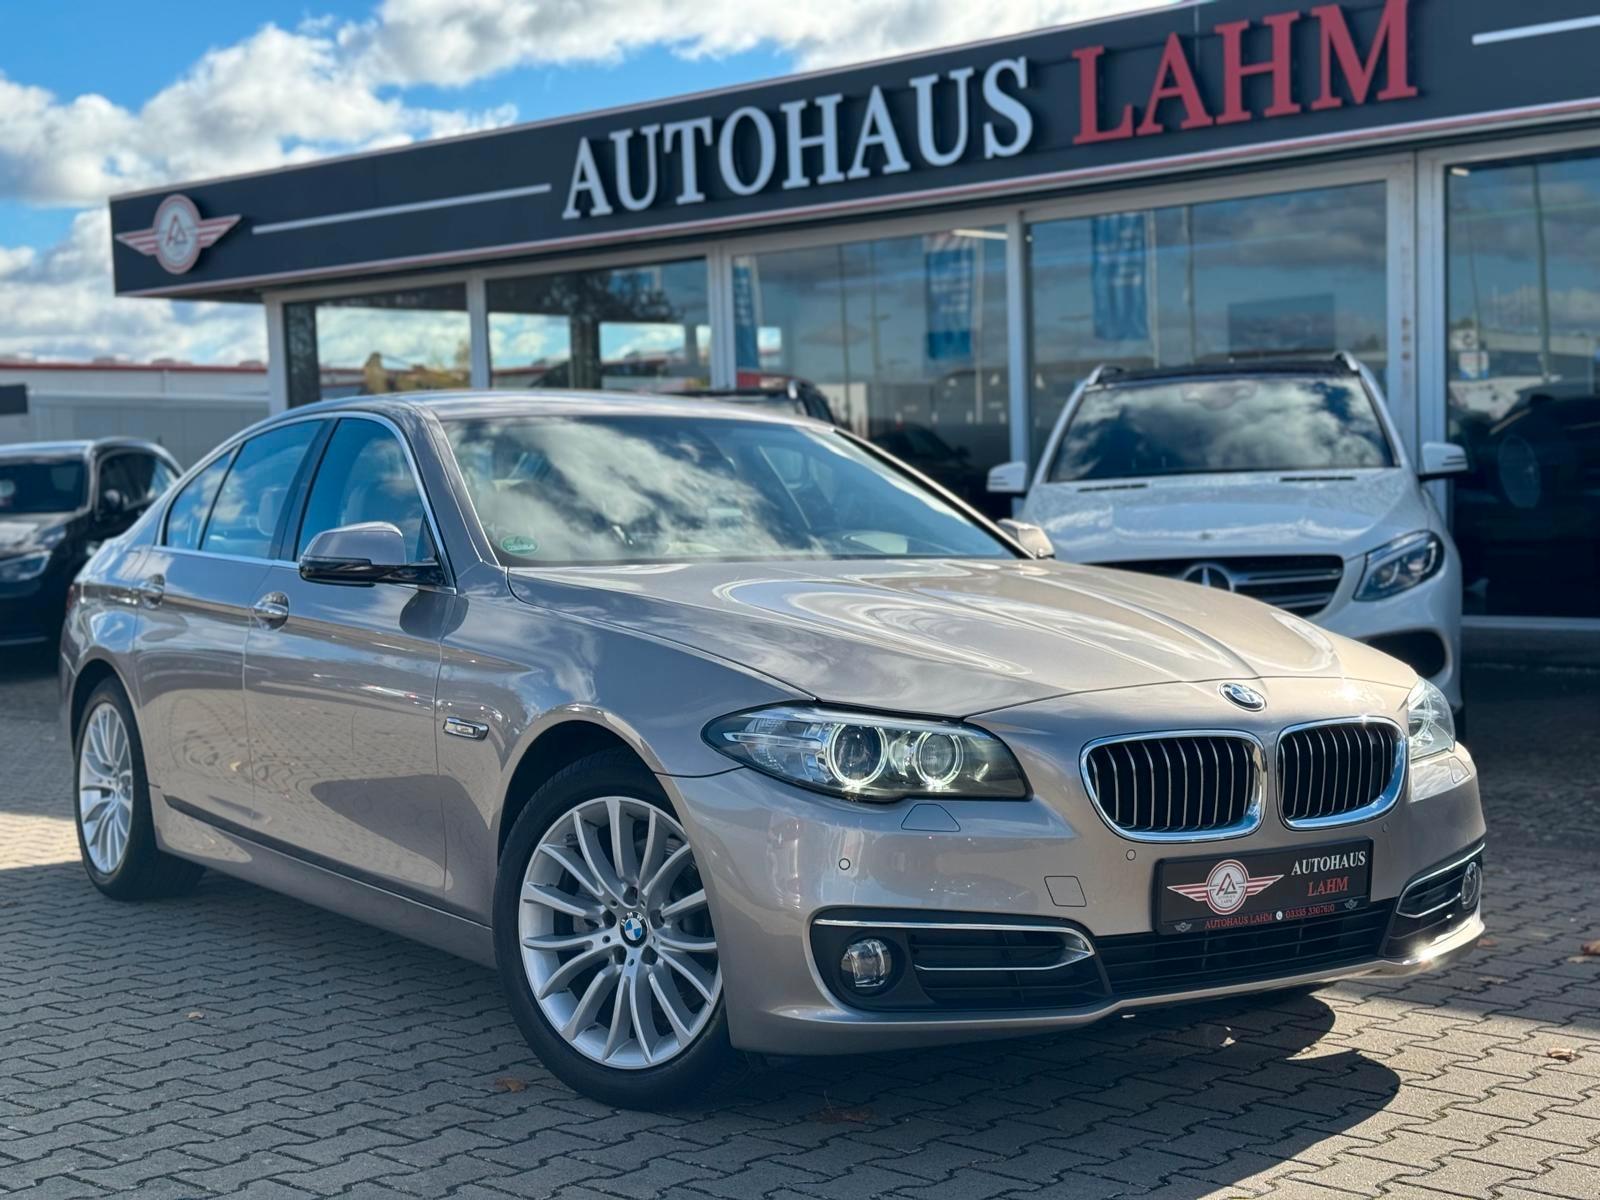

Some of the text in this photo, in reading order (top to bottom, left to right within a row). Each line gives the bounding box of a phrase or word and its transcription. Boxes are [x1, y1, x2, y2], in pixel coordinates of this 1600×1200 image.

[562, 0, 1418, 219] AUTOHAUS LAHM
[1291, 851, 1366, 875] AUTOHAUS
[1307, 876, 1349, 897] LAHM
[1205, 916, 1249, 929] AUTOHAUS
[1250, 912, 1273, 924] LAHM
